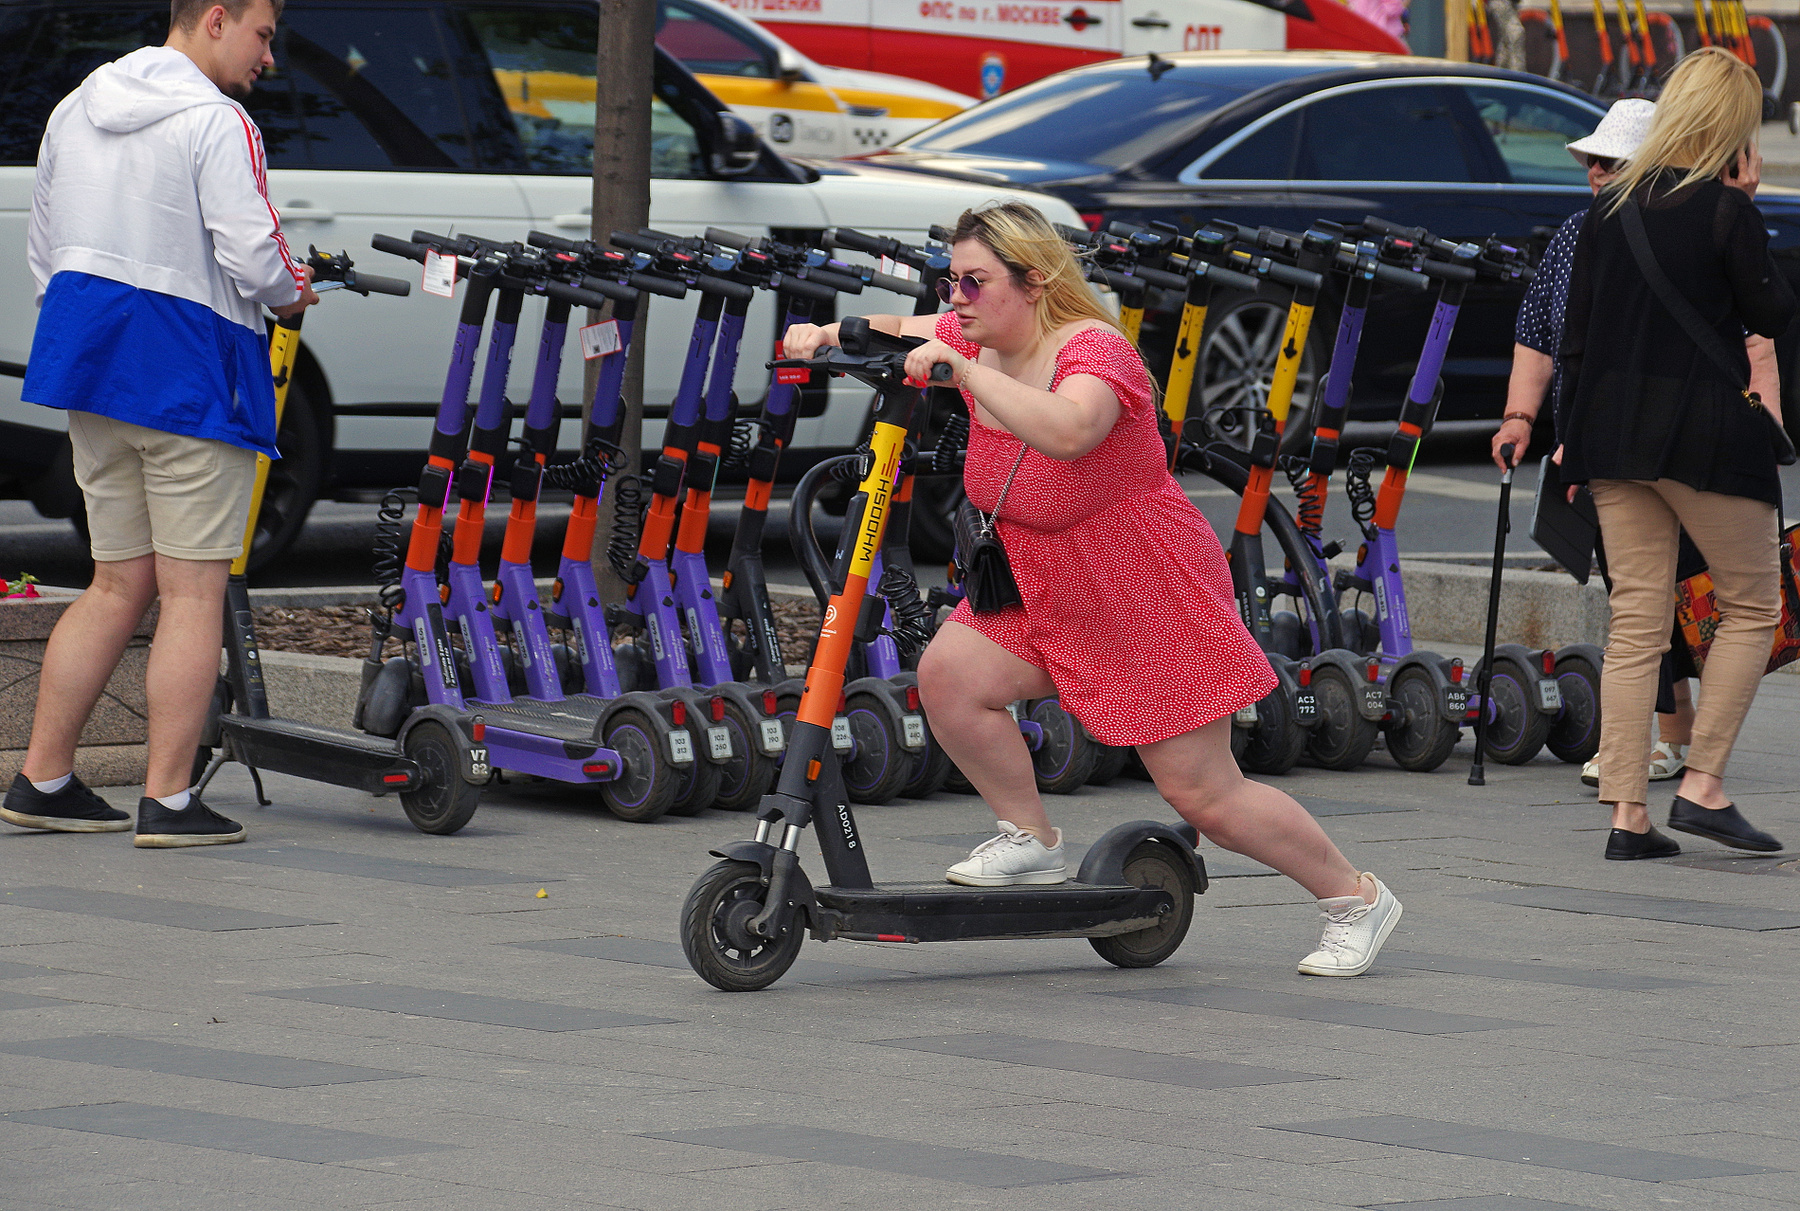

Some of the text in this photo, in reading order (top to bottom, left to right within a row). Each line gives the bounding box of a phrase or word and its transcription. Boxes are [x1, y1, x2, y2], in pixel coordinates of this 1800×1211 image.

[998, 5, 1062, 25] МОСКВЕ
[859, 478, 890, 562] WHOOSH
[1297, 695, 1315, 703] AC3
[1365, 691, 1383, 699] AC7
[1447, 692, 1465, 700] AB6
[1367, 701, 1384, 709] 004
[1299, 706, 1315, 714] 772
[470, 749, 487, 761] V7
